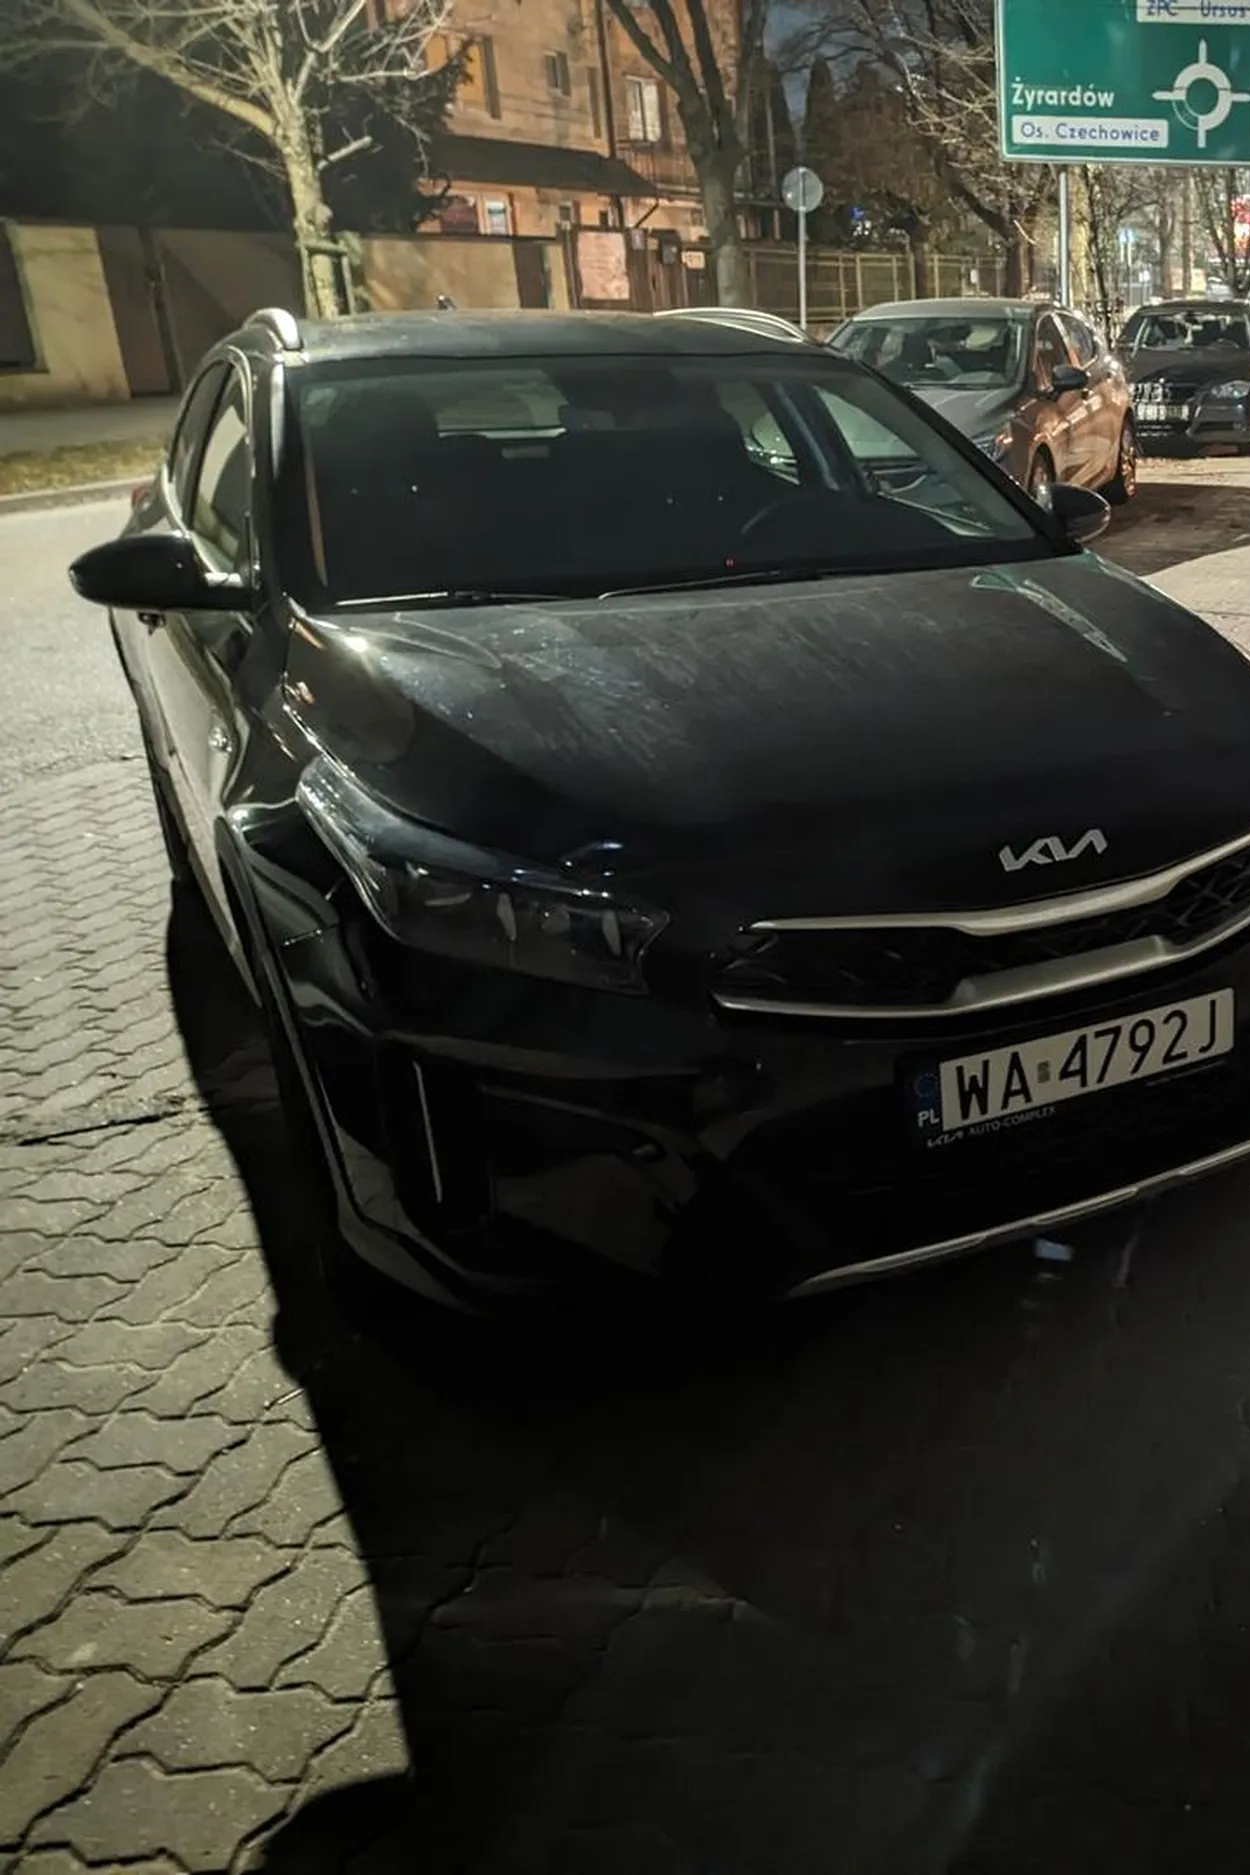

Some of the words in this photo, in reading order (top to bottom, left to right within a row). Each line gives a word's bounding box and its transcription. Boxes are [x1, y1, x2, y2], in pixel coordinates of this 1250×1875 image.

[1011, 77, 1115, 108] Żyrardów
[1020, 122, 1049, 139] Os.
[1055, 123, 1161, 143] Czechowice
[1000, 829, 1108, 872] KIA
[955, 1051, 1033, 1121] WA
[1058, 999, 1217, 1088] 4792J
[917, 1108, 939, 1128] PL
